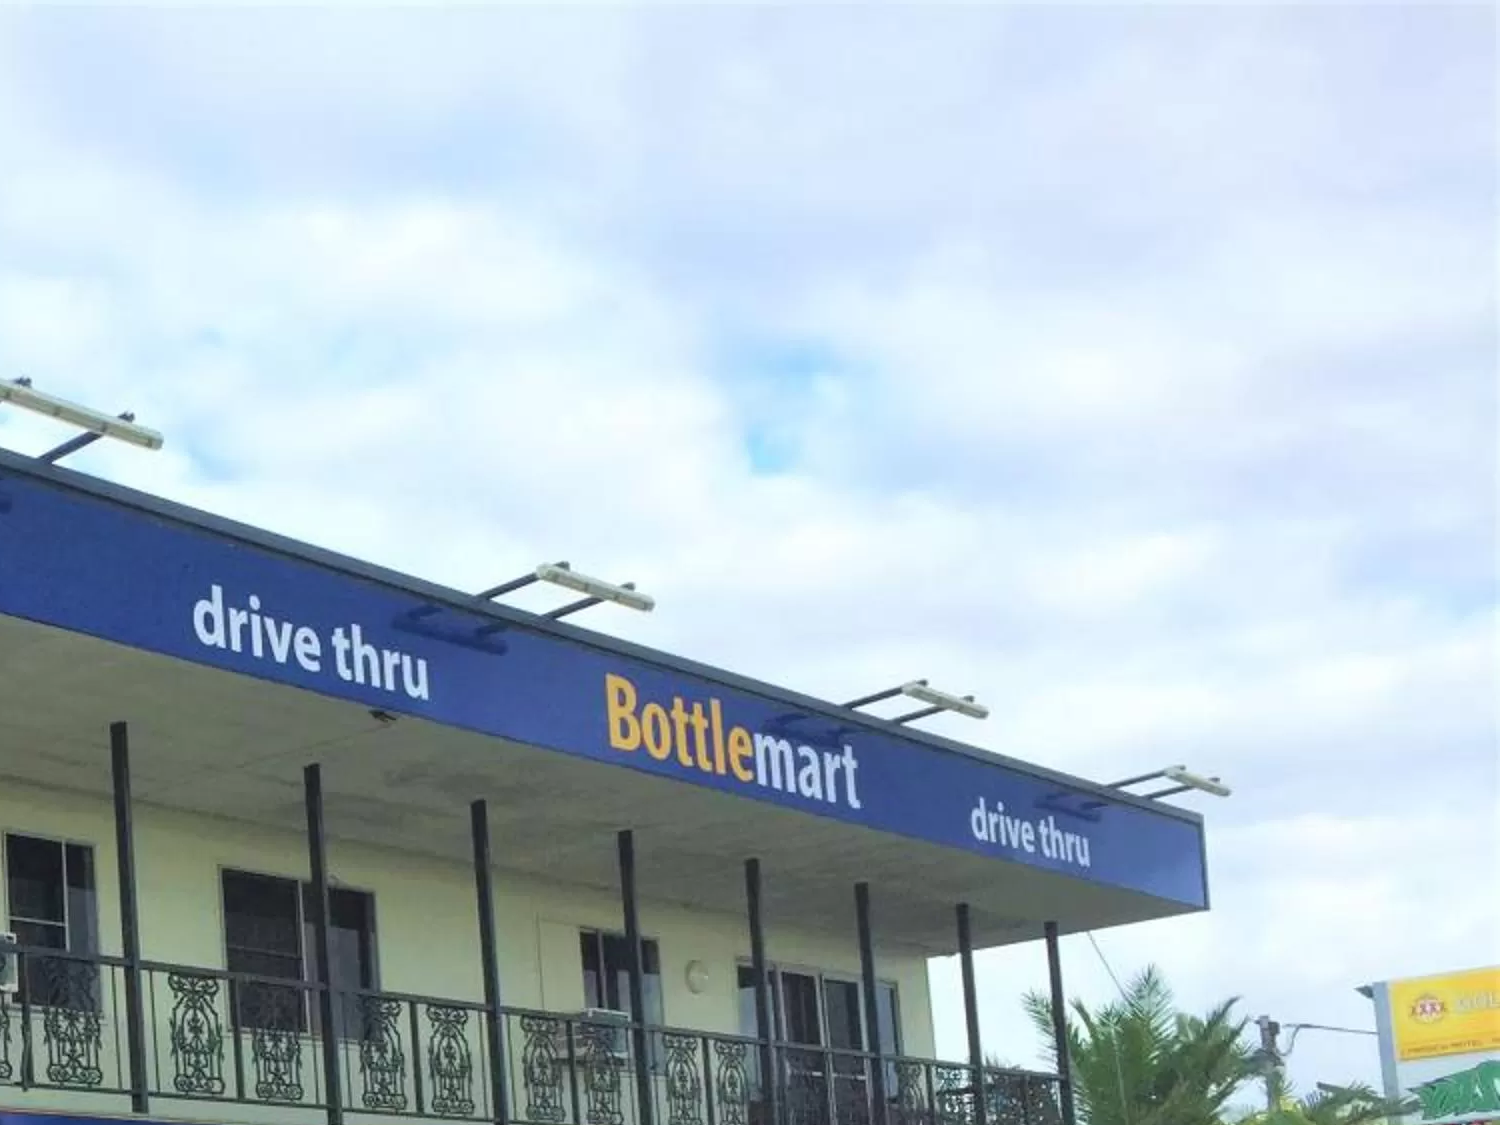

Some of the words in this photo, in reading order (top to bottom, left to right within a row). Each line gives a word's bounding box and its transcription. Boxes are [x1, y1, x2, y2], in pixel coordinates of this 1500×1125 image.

[193, 584, 322, 673] drive
[331, 624, 429, 700] thru
[605, 672, 861, 809] Bottlemart
[971, 796, 1035, 853] drive
[1039, 816, 1090, 868] thru
